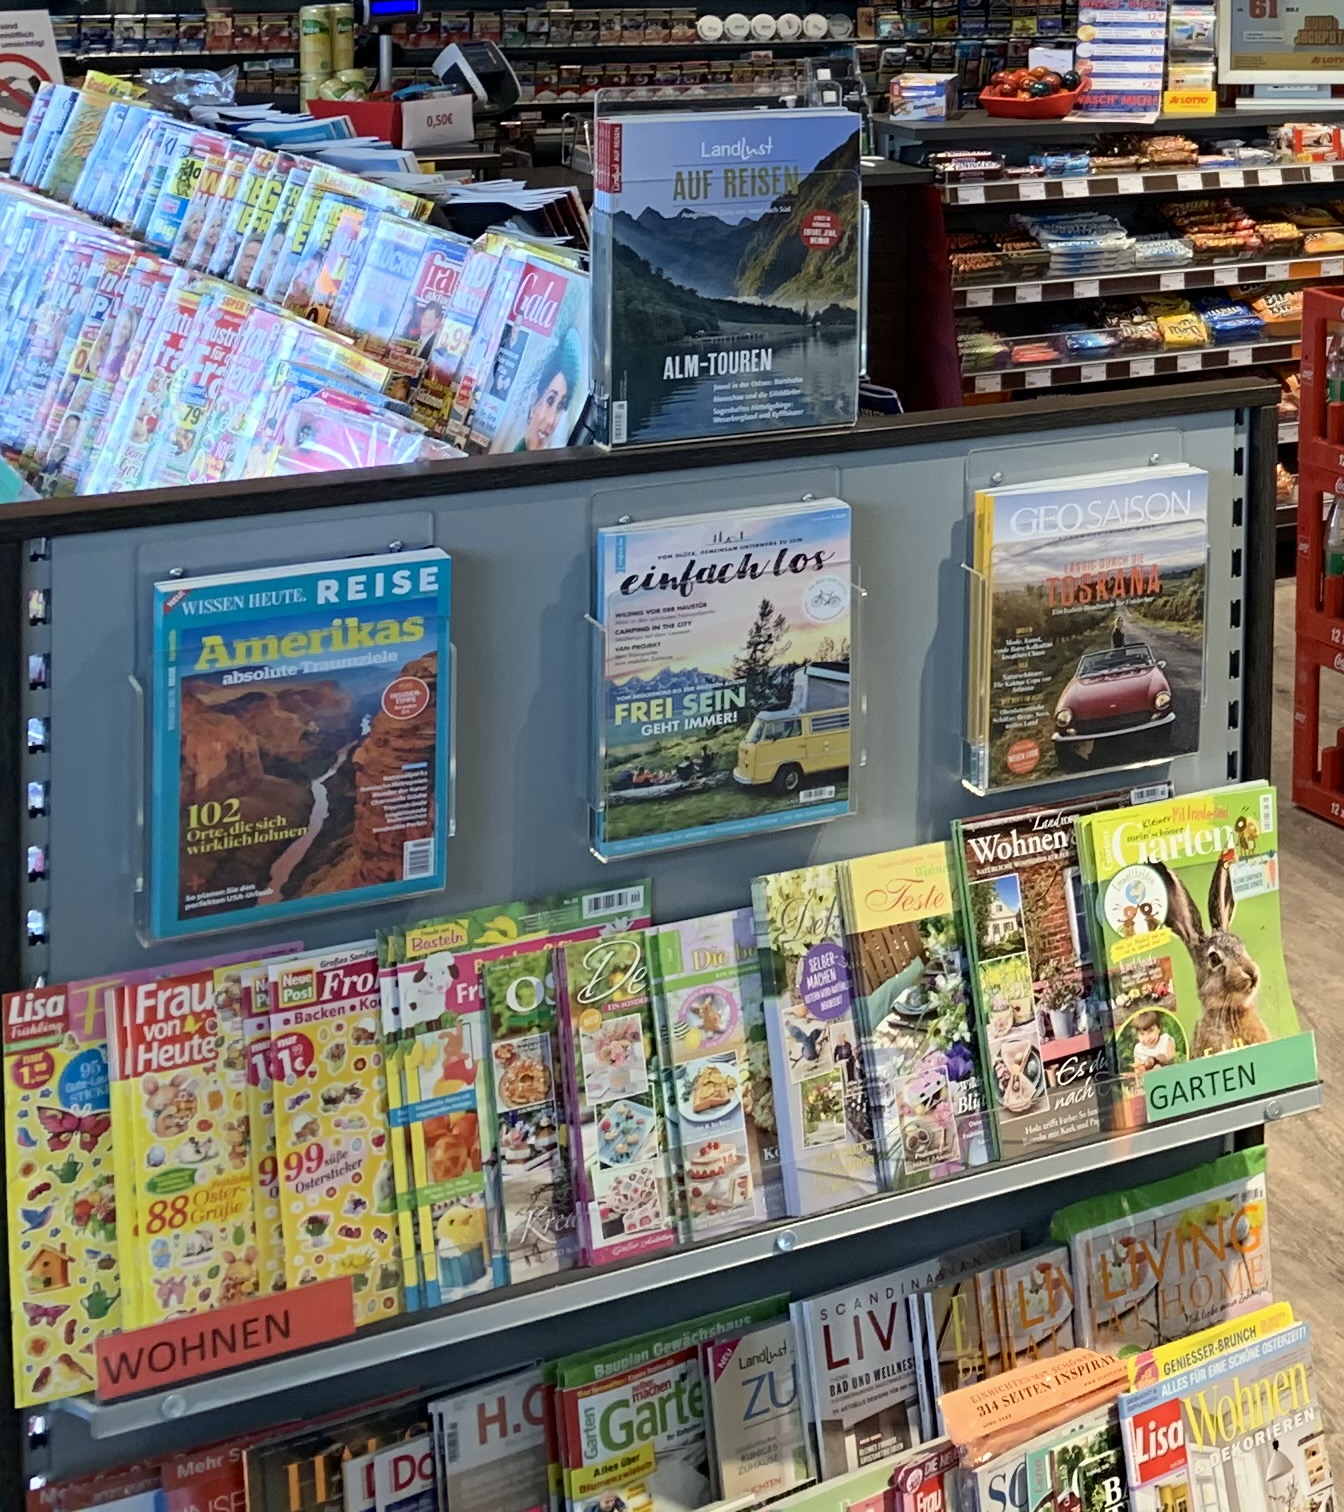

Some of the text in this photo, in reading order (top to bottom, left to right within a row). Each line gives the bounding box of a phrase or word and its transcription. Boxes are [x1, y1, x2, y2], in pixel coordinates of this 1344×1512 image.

[1180, 96, 1208, 105] LOTTO
[426, 113, 453, 128] 0,50€
[673, 165, 800, 202] AUF REISEN
[514, 271, 560, 329] Gala
[663, 348, 773, 380] ALM-TOUREN
[1010, 489, 1191, 536] GEO SAISON
[620, 548, 835, 598] einfach los
[1046, 564, 1161, 608] TOSKANA
[182, 566, 439, 616] WISSEN HEUTE. REISE
[194, 616, 425, 671] Amerikas
[223, 650, 398, 685] absolute Traumziele
[614, 697, 673, 726] FREI
[683, 686, 746, 718] SEIN
[641, 712, 738, 737] GEHT IMMER!
[187, 798, 240, 828] 102
[187, 815, 287, 843] Orte, die sich
[187, 827, 308, 857] wirklich lohnen
[967, 828, 1068, 866] Wohnen
[1112, 821, 1237, 869] Garten
[1127, 831, 1149, 843] mein
[864, 878, 946, 912] Feste
[412, 931, 465, 953] Basteln
[282, 972, 313, 988] Neue
[807, 971, 837, 990] MACHEN
[809, 954, 839, 974] SELBER-
[8, 992, 64, 1027] Lisa
[136, 977, 217, 1026] Frau
[283, 986, 313, 1004] Post
[10, 1021, 64, 1039] Frühling
[143, 1020, 181, 1042] von
[295, 1005, 346, 1025] Backen
[137, 1037, 217, 1073] Heute
[1056, 1056, 1087, 1086] Es
[1055, 1076, 1095, 1111] nach
[1150, 1061, 1256, 1111] GARTEN
[284, 1143, 325, 1183] 99
[295, 1157, 364, 1194] Ostersticker
[324, 1149, 348, 1168] süße
[147, 1191, 189, 1234] 88
[190, 1202, 243, 1226] Grüße
[192, 1188, 248, 1208] Oster-
[1100, 1204, 1263, 1302] LIVING
[102, 1308, 292, 1385] WOHNEN
[594, 1314, 752, 1381] Bauplan Gewächshaus
[717, 1347, 734, 1370] NEU
[1161, 1327, 1308, 1398] ALLES FÜR EINE SCHÖNE OSTERZEIT!
[1163, 1325, 1257, 1376] GENIESSER-BRUNCH
[830, 1371, 871, 1397] BAD UND
[977, 1381, 1052, 1418] 314 SEITEN
[1182, 1362, 1311, 1454] Wohnen
[583, 1406, 597, 1461] Garten
[1135, 1418, 1185, 1466] Lisa
[1209, 1407, 1316, 1468] DEKORIEREN
[176, 1455, 223, 1480] Mehr
[593, 1452, 641, 1480] Alles über
